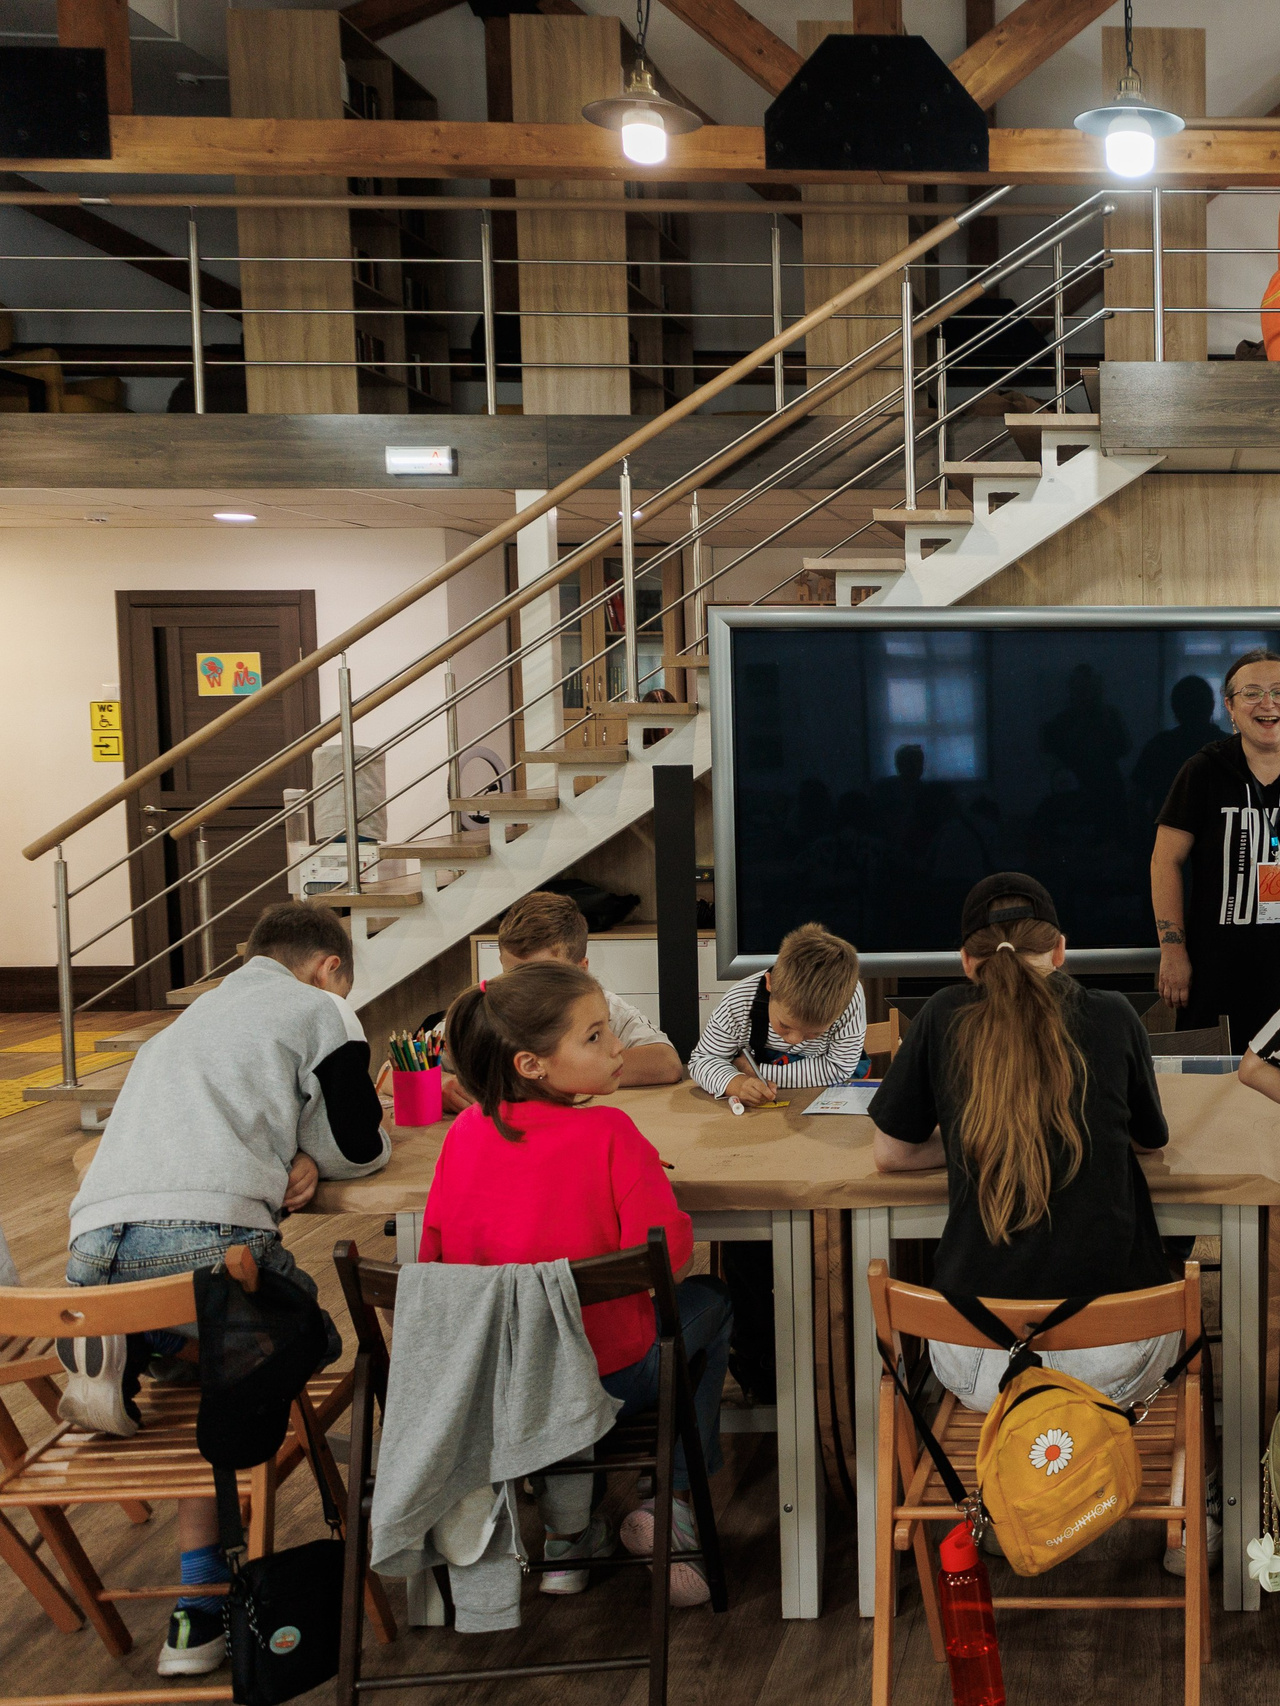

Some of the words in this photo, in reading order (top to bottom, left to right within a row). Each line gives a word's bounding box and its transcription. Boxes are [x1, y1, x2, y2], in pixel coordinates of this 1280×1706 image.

[97, 704, 113, 713] WC
[1238, 831, 1248, 872] MARUNOUCHI
[1226, 896, 1235, 925] SHINJUKU
